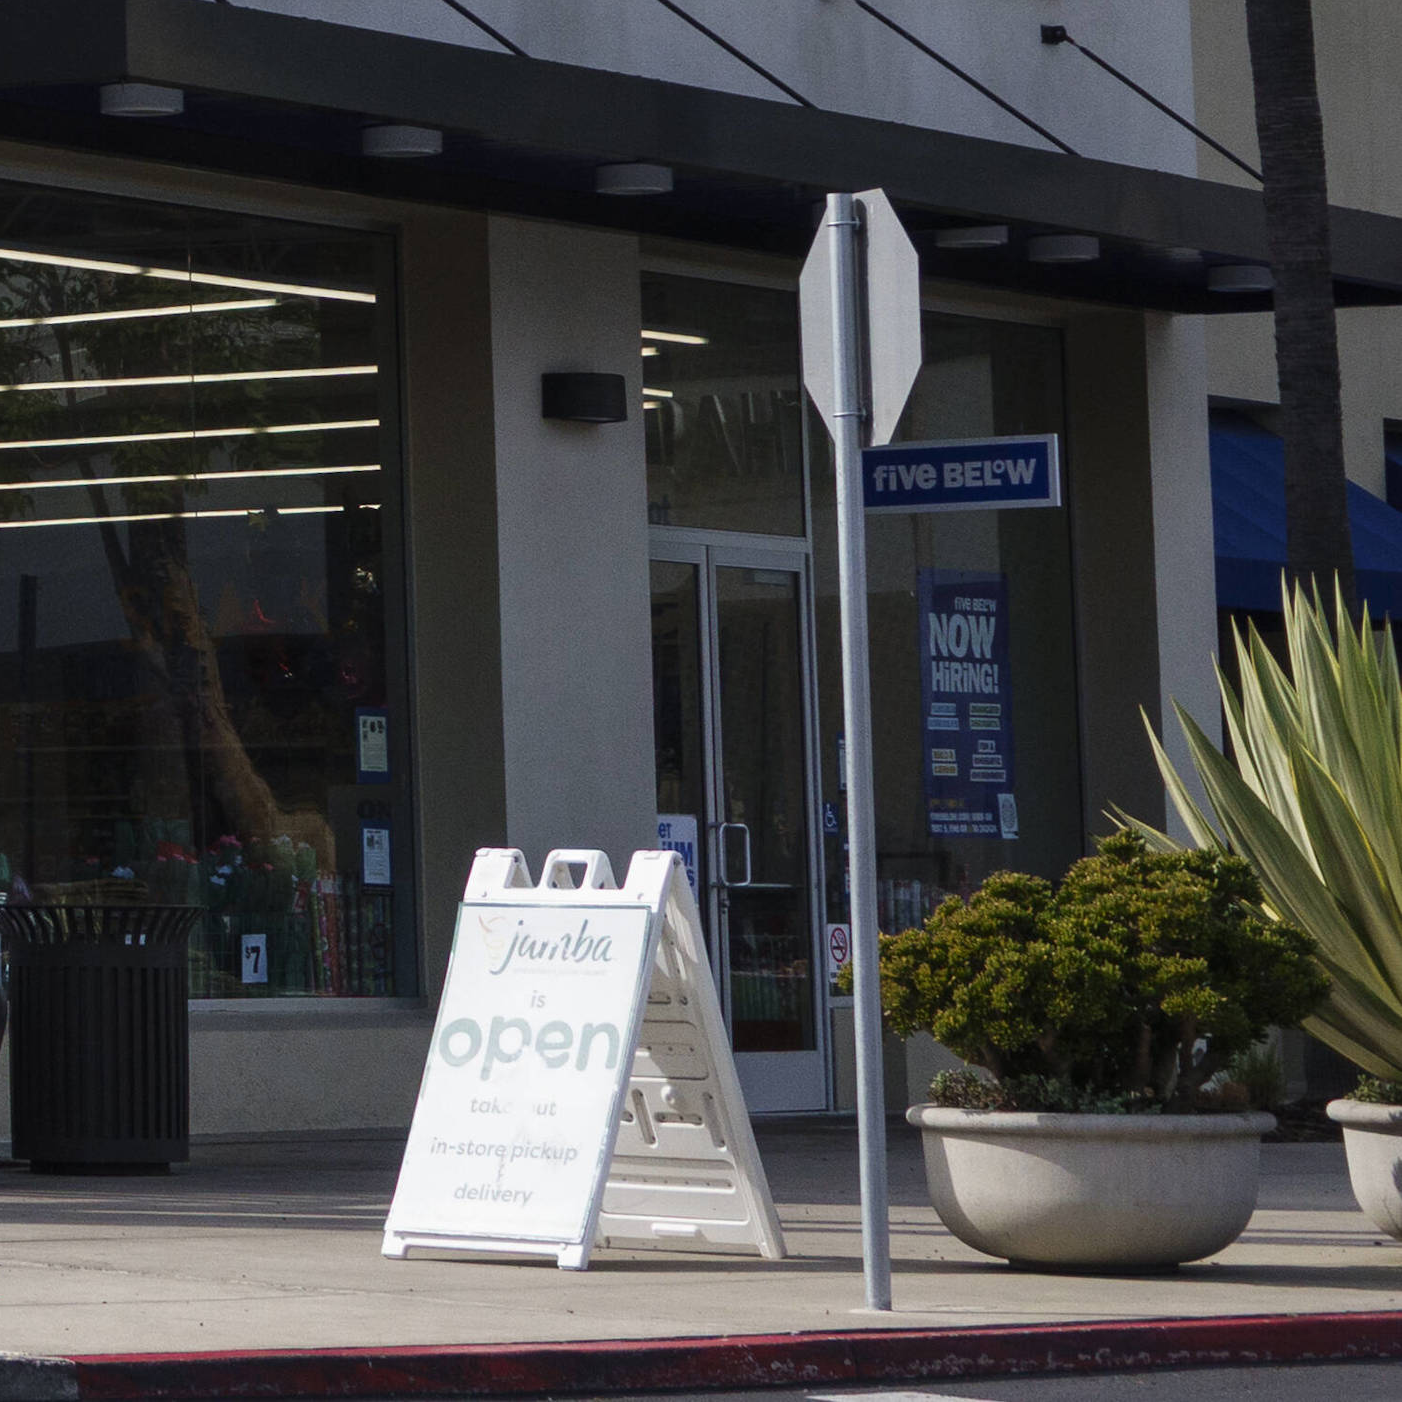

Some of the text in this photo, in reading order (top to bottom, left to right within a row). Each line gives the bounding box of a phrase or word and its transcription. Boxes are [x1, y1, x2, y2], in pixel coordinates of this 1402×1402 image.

[872, 457, 1038, 494] five BELOW
[927, 612, 997, 659] NOW
[245, 945, 261, 974] $7
[490, 918, 614, 975] jamba
[530, 989, 546, 1009] is
[438, 1016, 621, 1081] open
[430, 1136, 579, 1166] in-store pickup
[453, 1181, 534, 1207] delivery
